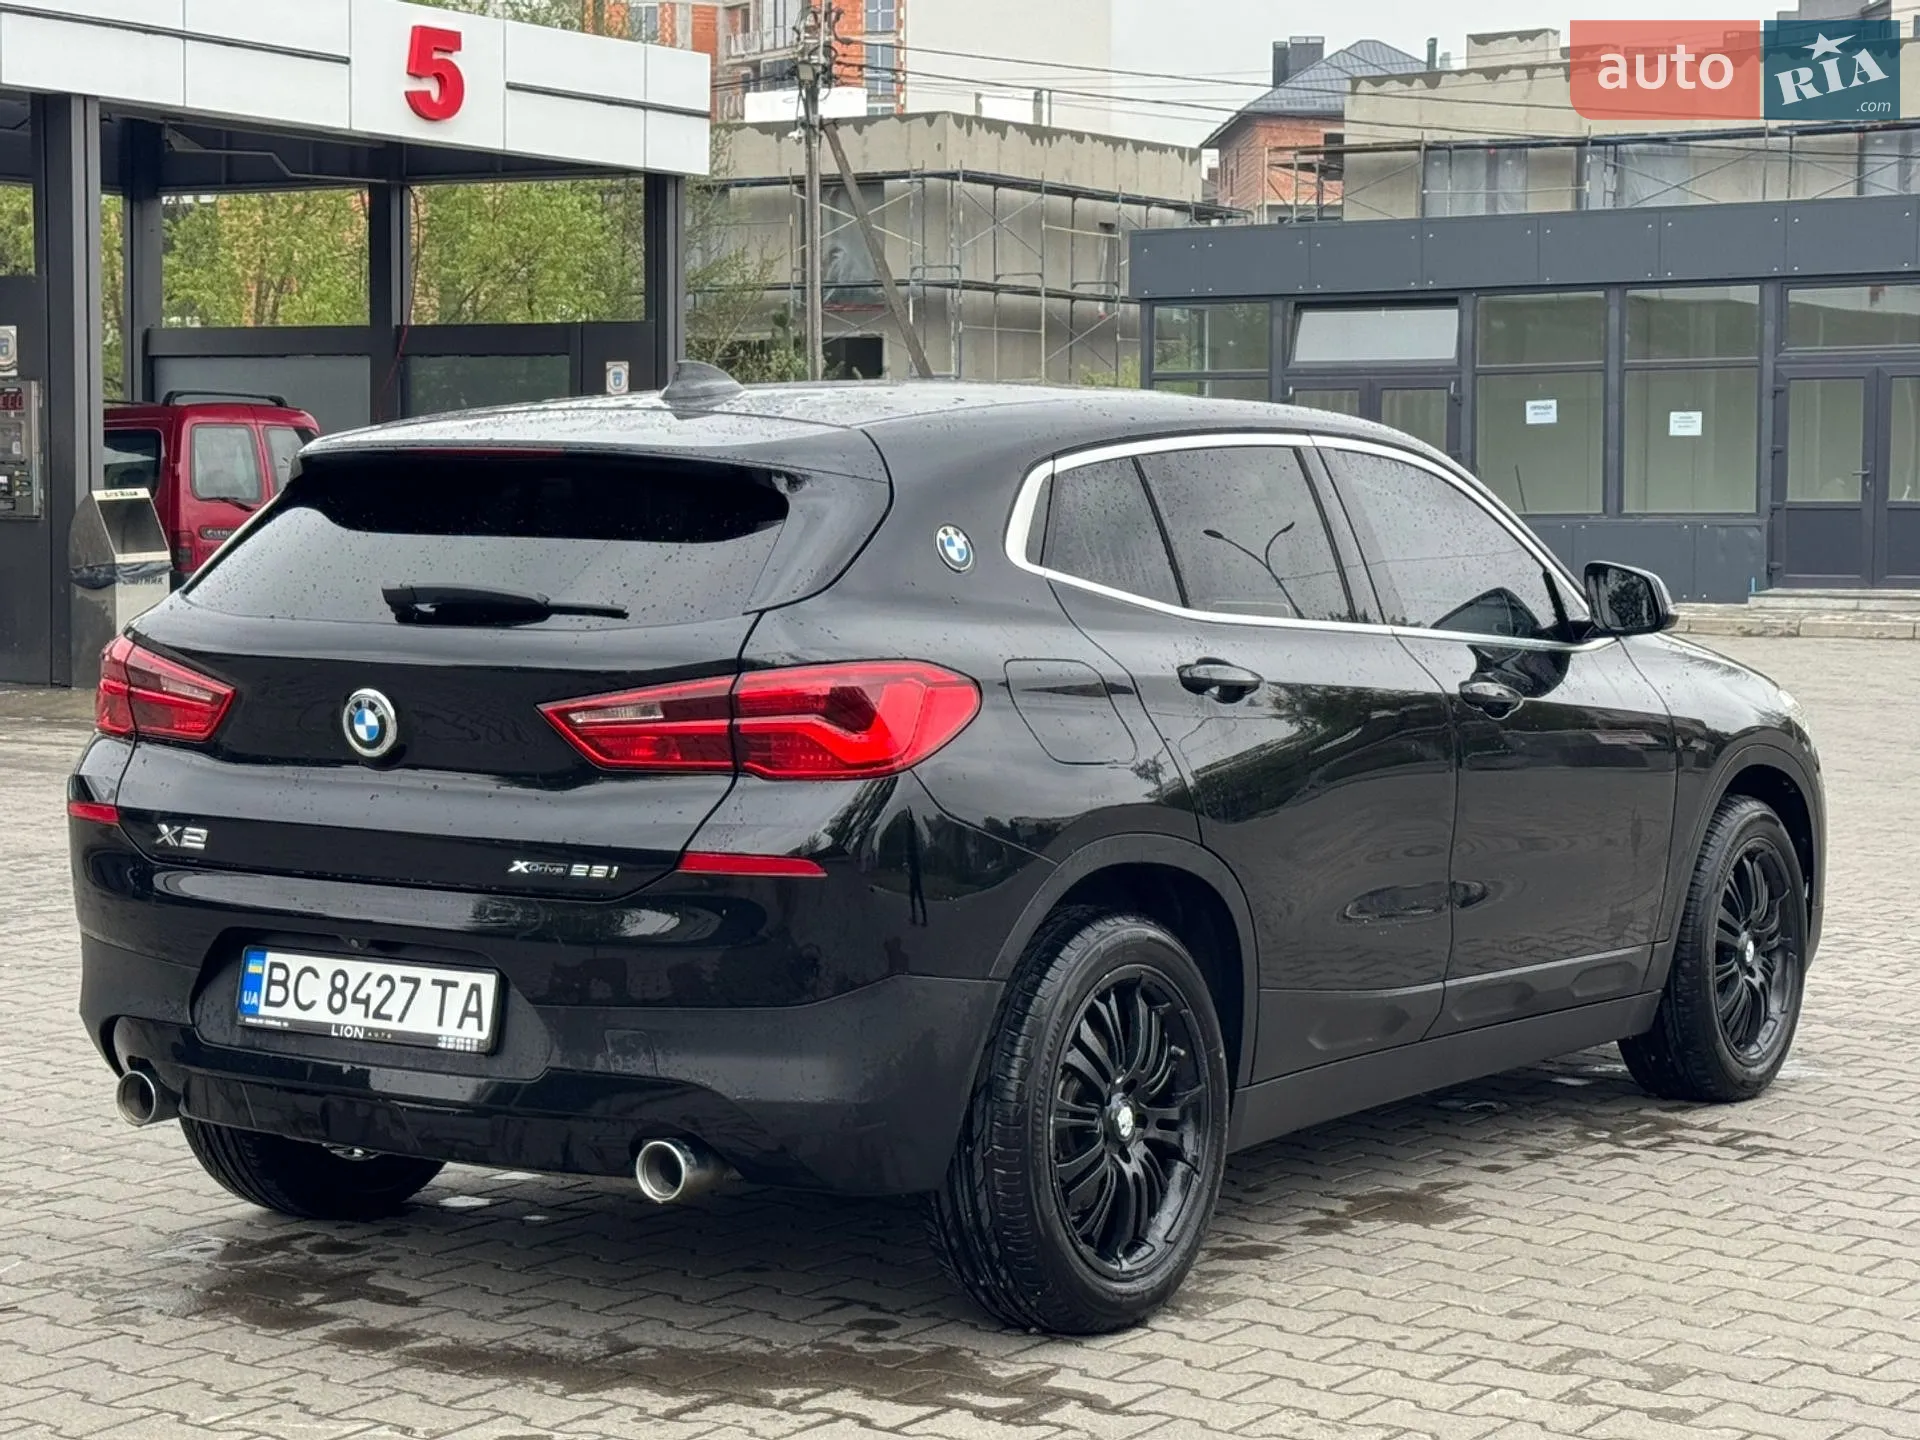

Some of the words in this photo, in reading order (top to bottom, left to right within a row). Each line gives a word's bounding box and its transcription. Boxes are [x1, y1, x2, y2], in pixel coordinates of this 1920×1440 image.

[404, 25, 465, 121] 5
[156, 823, 208, 850] X2
[243, 990, 259, 1006] UA
[263, 961, 321, 1012] BC
[326, 968, 422, 1024] 8427
[430, 978, 484, 1032] TA
[331, 1024, 364, 1039] LION
